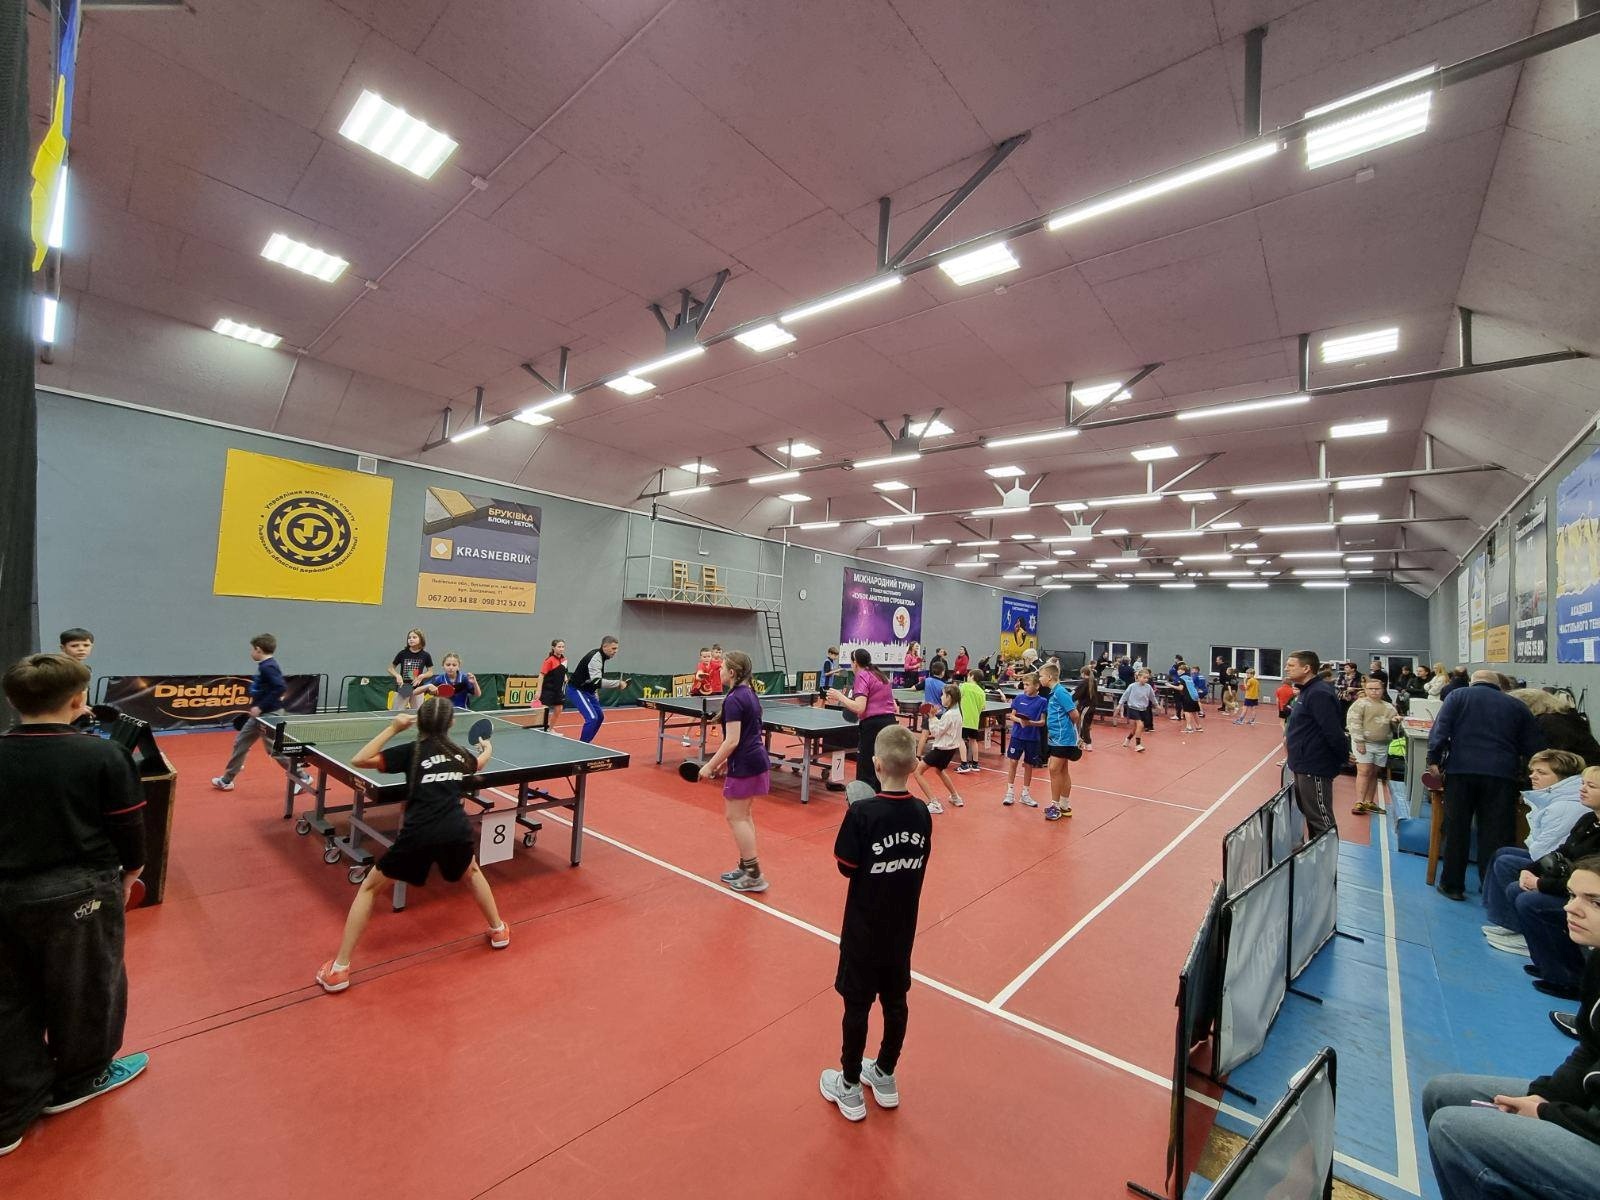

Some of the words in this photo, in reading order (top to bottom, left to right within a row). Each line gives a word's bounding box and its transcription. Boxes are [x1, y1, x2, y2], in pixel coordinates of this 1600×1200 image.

[487, 516, 510, 526] БЛОКИ
[488, 507, 534, 522] БРУКІВКА
[456, 546, 532, 564] KRASNEBRUK
[853, 573, 898, 589] МІЖНАРОДНИЙ
[898, 581, 916, 591] ТУРНІР
[428, 594, 441, 602] 067
[443, 595, 457, 603] 200
[154, 683, 246, 697] Didukh
[171, 696, 254, 708] acade
[836, 758, 841, 770] 7
[493, 824, 506, 845] 8
[871, 831, 926, 855] SUISSE
